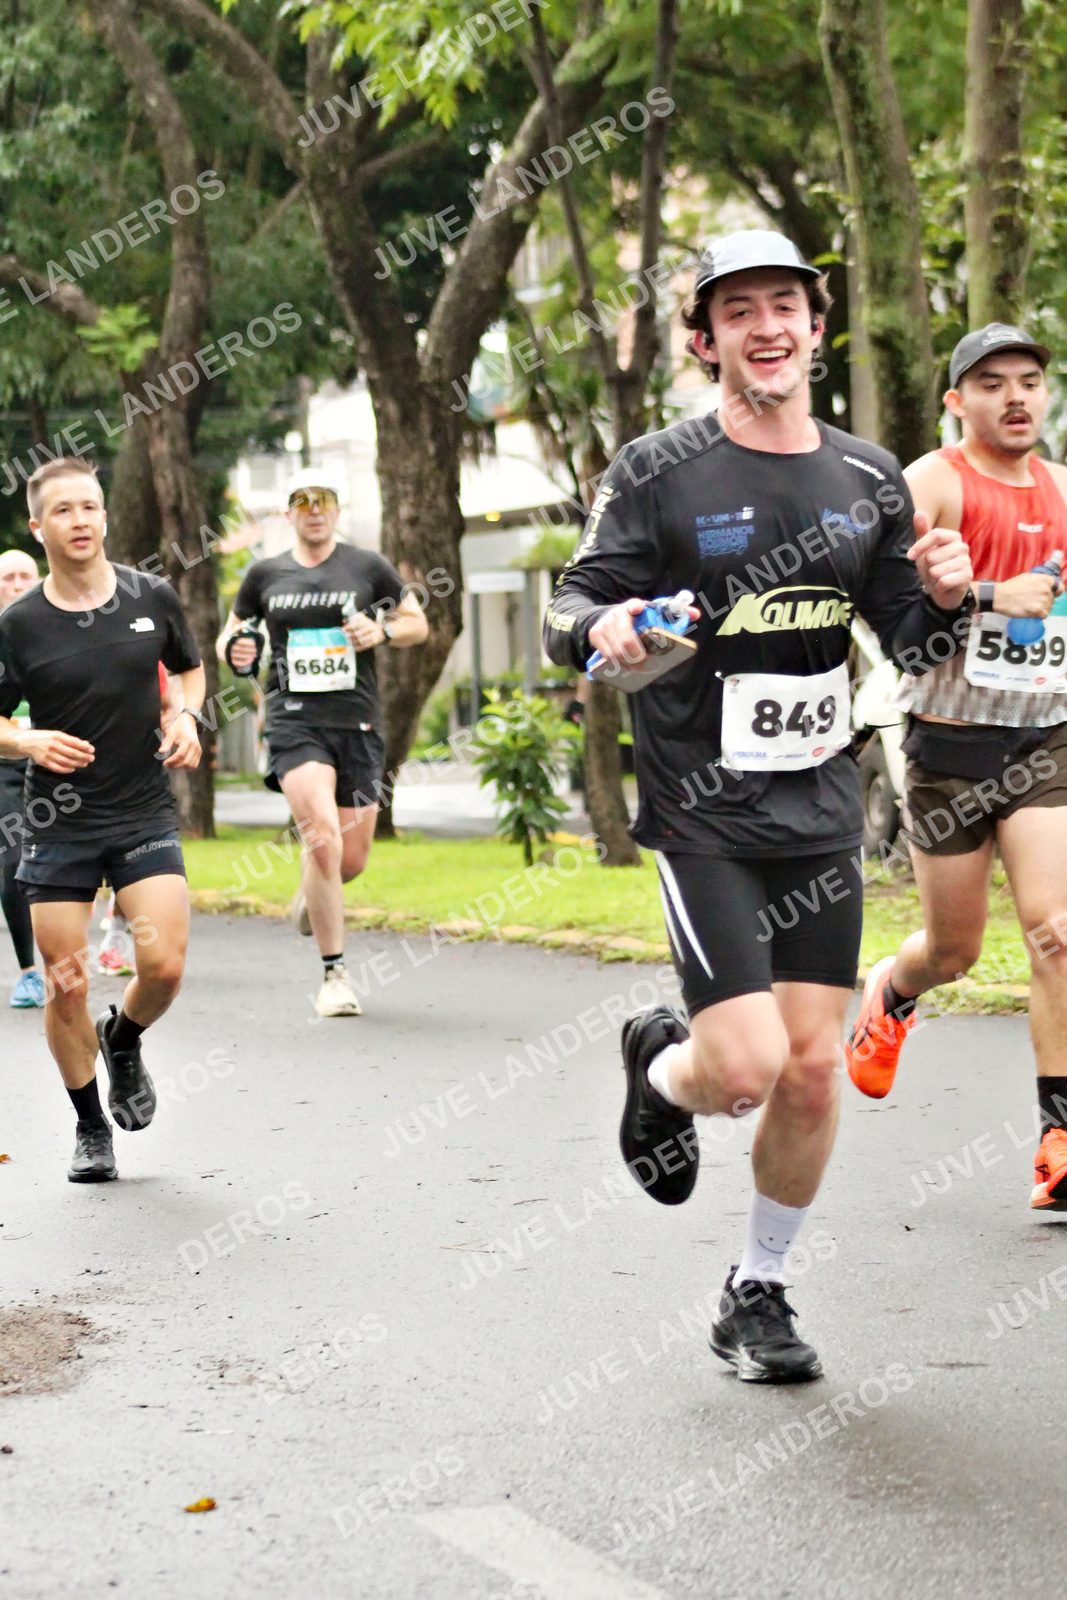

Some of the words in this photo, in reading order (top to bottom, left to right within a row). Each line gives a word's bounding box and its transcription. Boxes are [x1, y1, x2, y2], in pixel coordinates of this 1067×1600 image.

[294, 657, 350, 675] 6684
[975, 630, 1065, 667] 5899
[751, 695, 837, 738] 849
